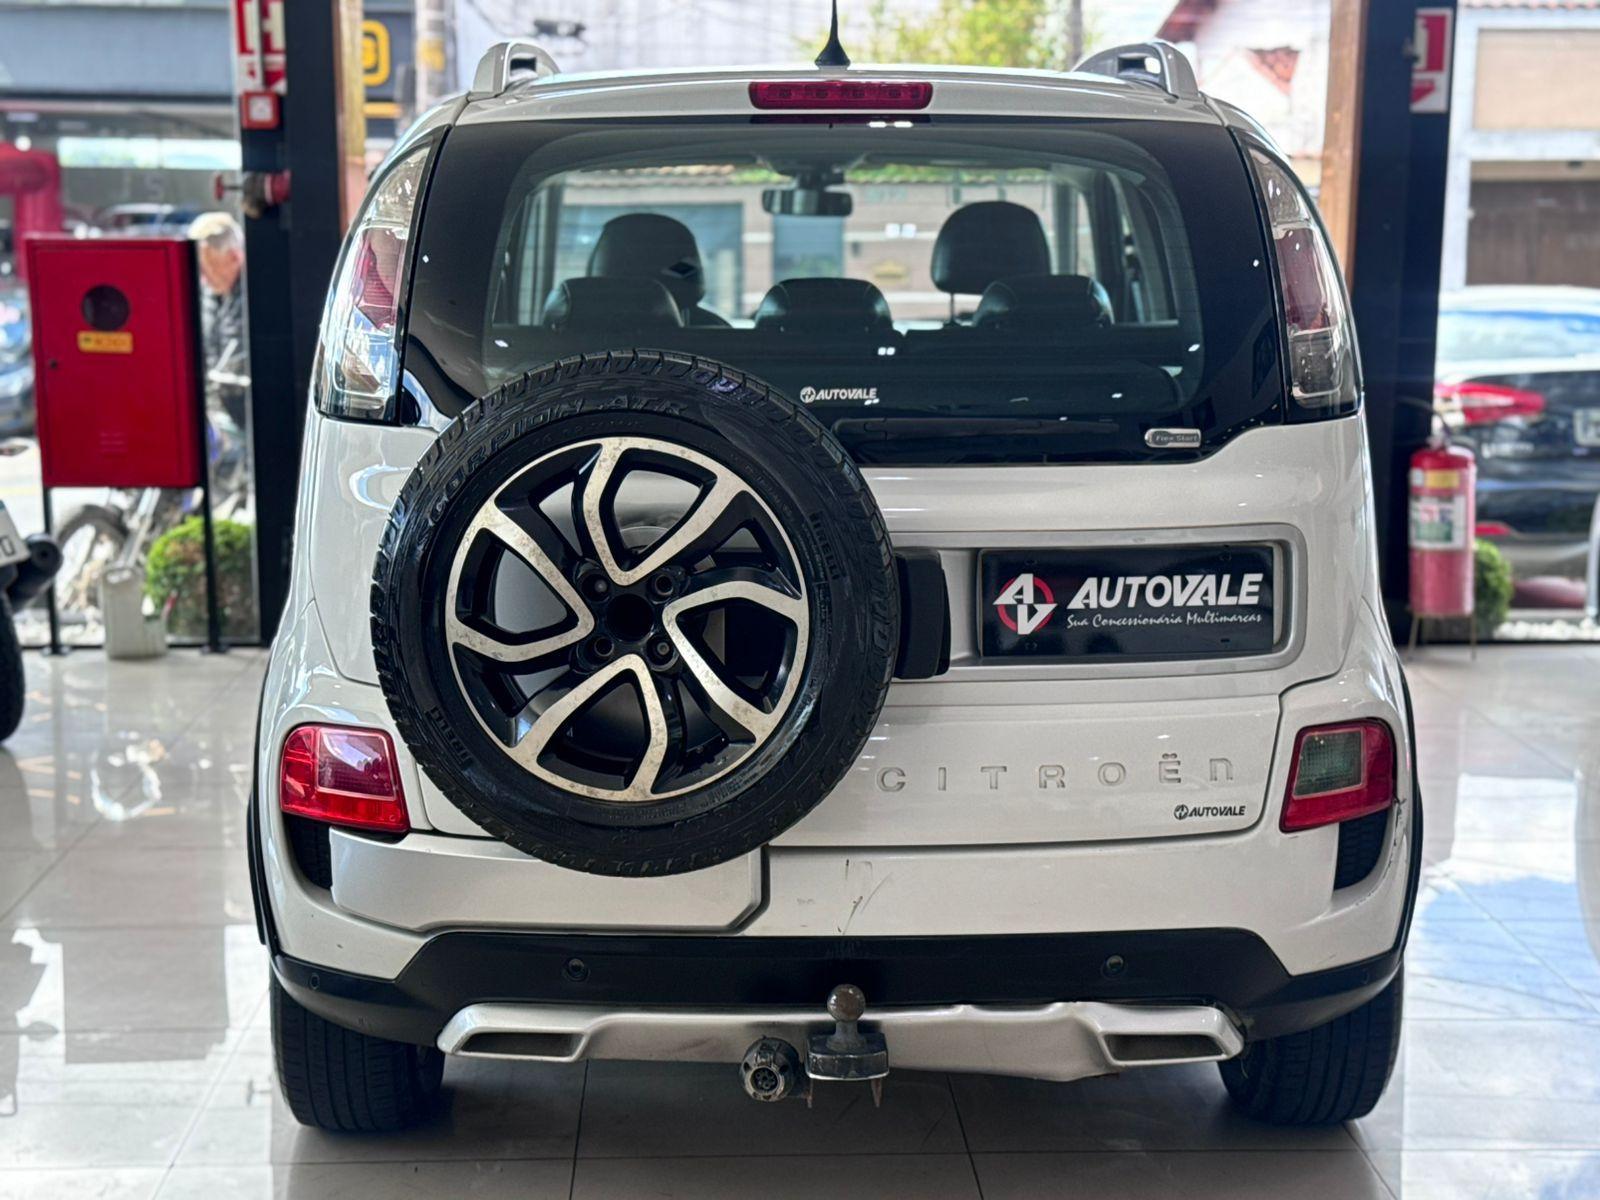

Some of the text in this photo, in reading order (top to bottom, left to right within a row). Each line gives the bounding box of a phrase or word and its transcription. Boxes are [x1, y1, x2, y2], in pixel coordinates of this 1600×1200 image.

[815, 387, 877, 400] AUTOVALE
[1066, 573, 1263, 609] AUTOVALE
[1066, 614, 1089, 629] Sua
[1186, 611, 1262, 625] Multimarcas
[1188, 805, 1246, 817] AUTOVALE
